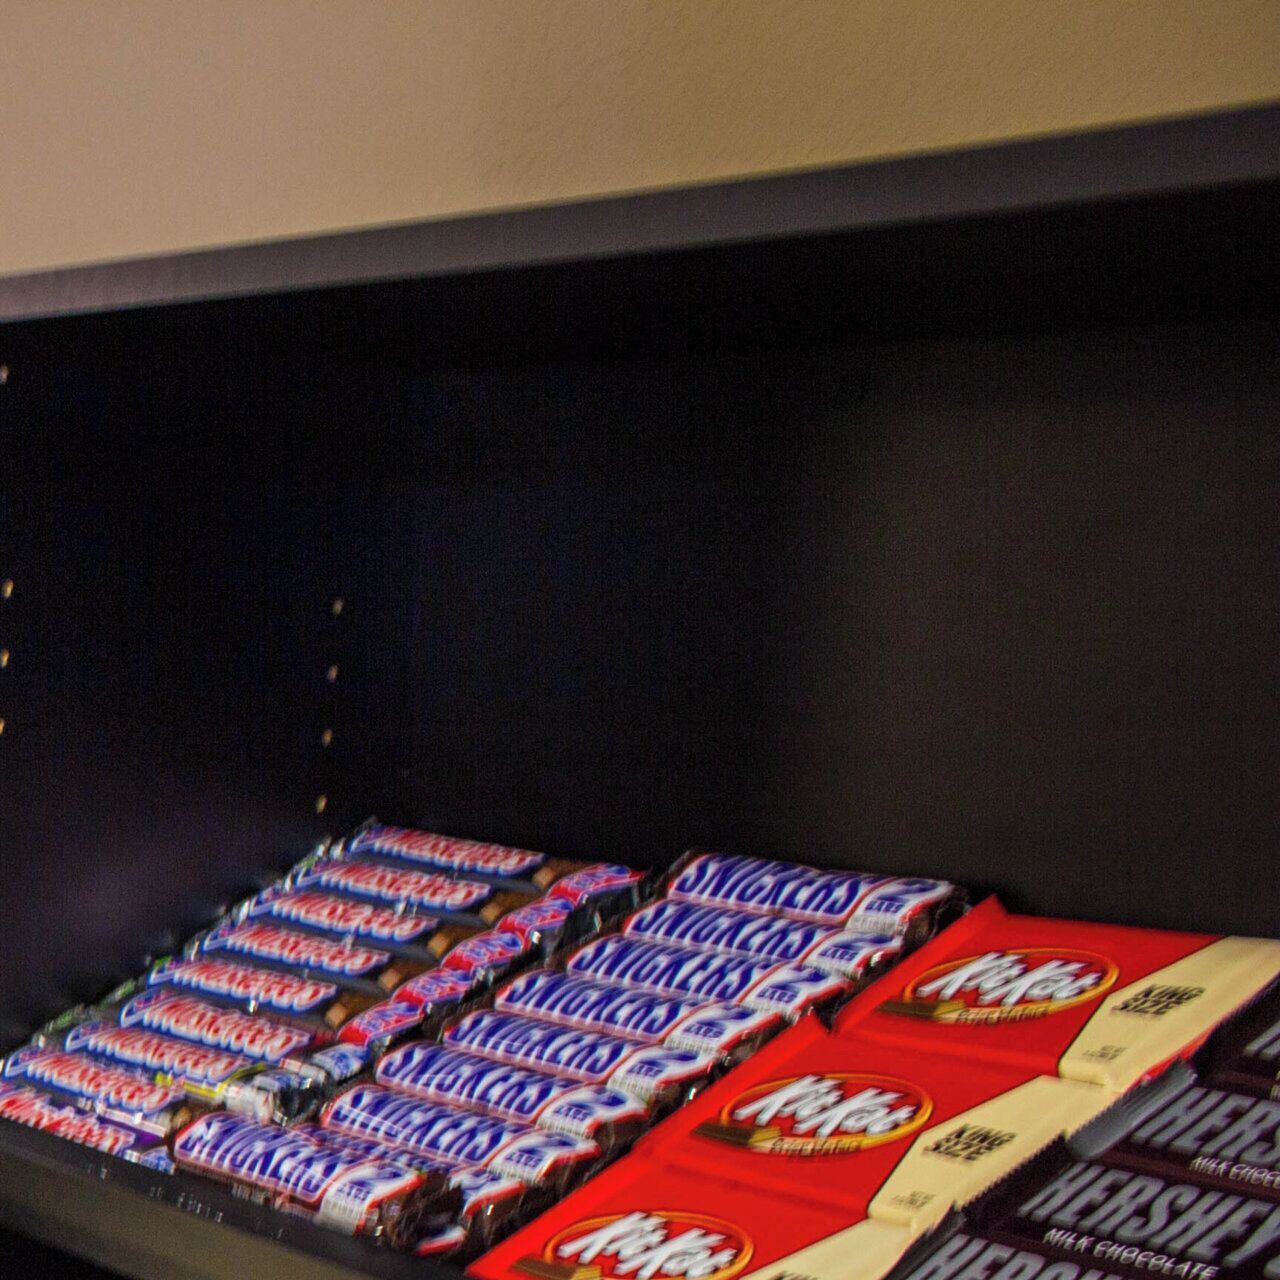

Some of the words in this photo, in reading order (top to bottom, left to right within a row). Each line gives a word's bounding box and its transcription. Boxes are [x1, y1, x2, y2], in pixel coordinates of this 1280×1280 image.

[674, 853, 862, 917] SNICKERS
[628, 901, 817, 960] SNICKERS
[570, 936, 753, 1001] SNICKERS
[504, 971, 681, 1036] SNICKERS
[446, 1010, 624, 1076] SNICKERS
[379, 1042, 553, 1115] SNICKERS
[331, 1086, 503, 1162] SNICKERS
[1017, 1161, 1280, 1280] HERSHEY
[1044, 1226, 1094, 1252] MILK
